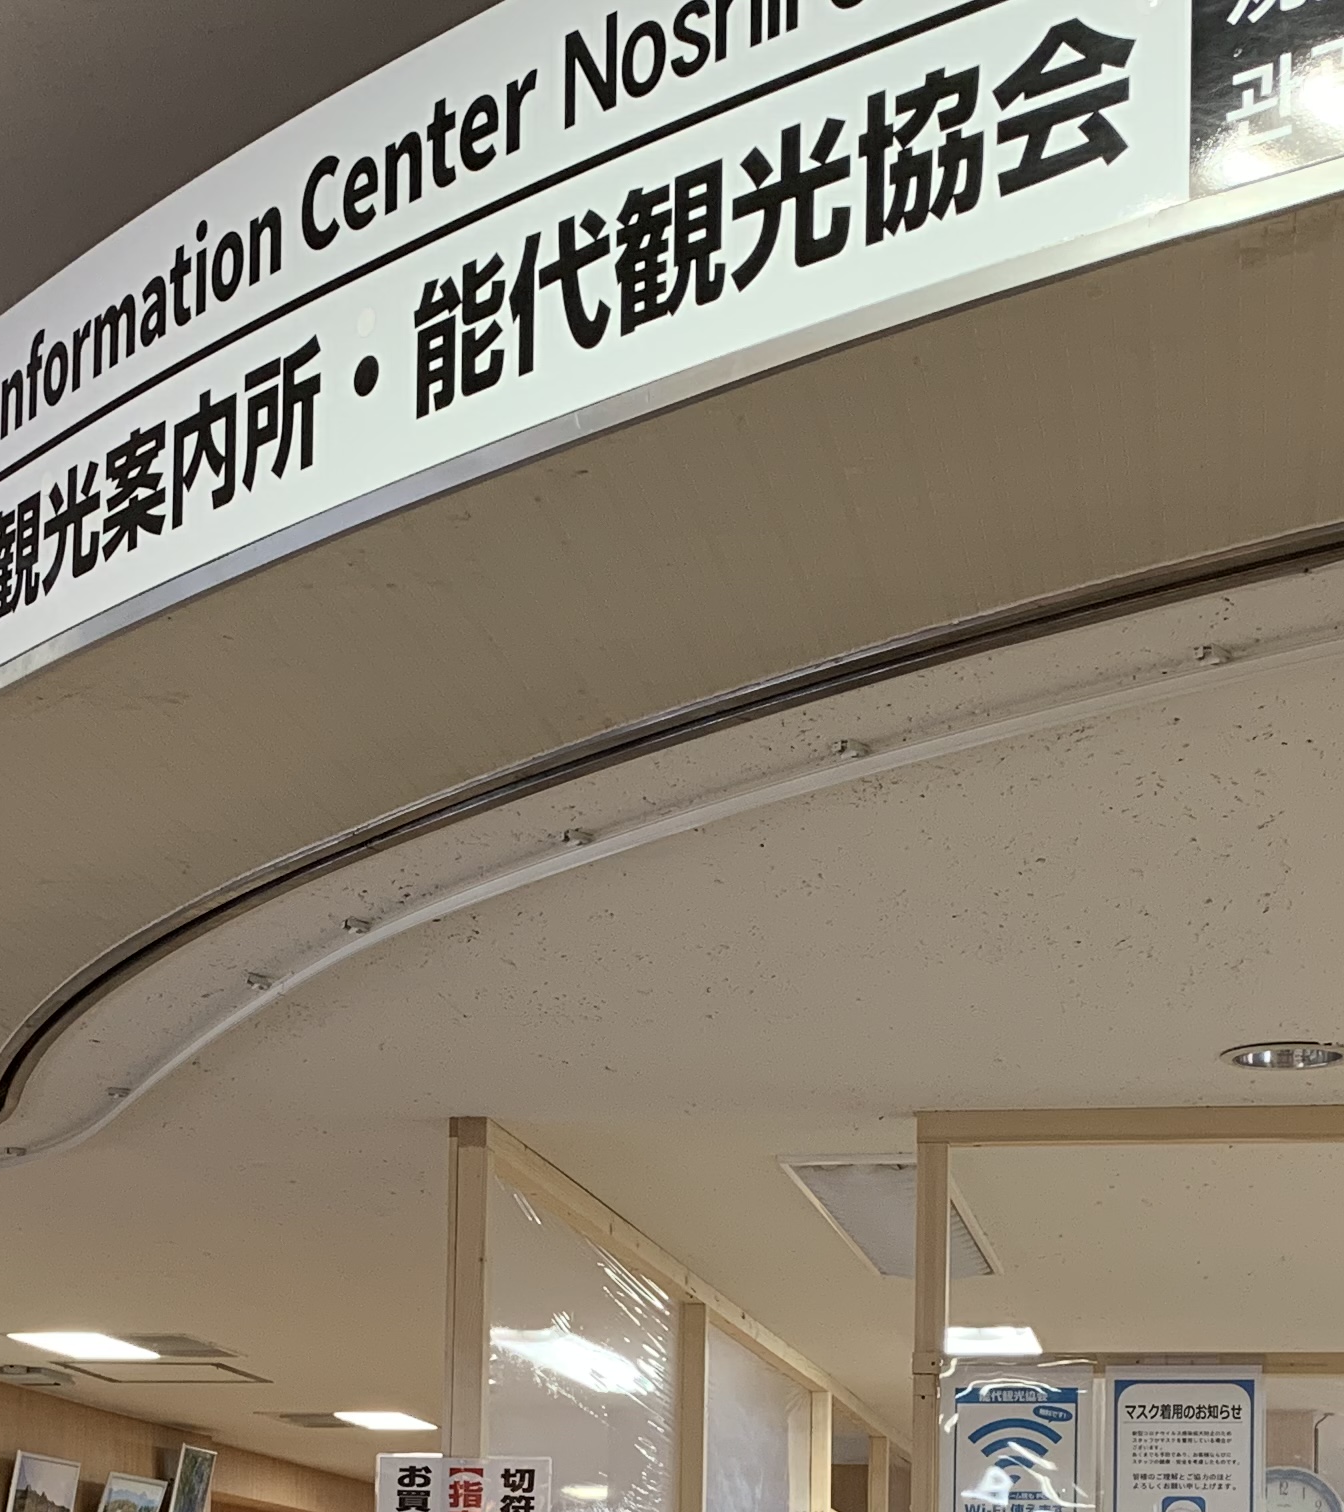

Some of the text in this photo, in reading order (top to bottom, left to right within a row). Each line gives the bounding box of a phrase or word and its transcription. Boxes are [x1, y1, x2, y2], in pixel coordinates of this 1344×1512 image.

[301, 66, 538, 252] Center
[1125, 1403, 1243, 1420] マスク着用のお知らせ
[1279, 1480, 1289, 1496] 12
